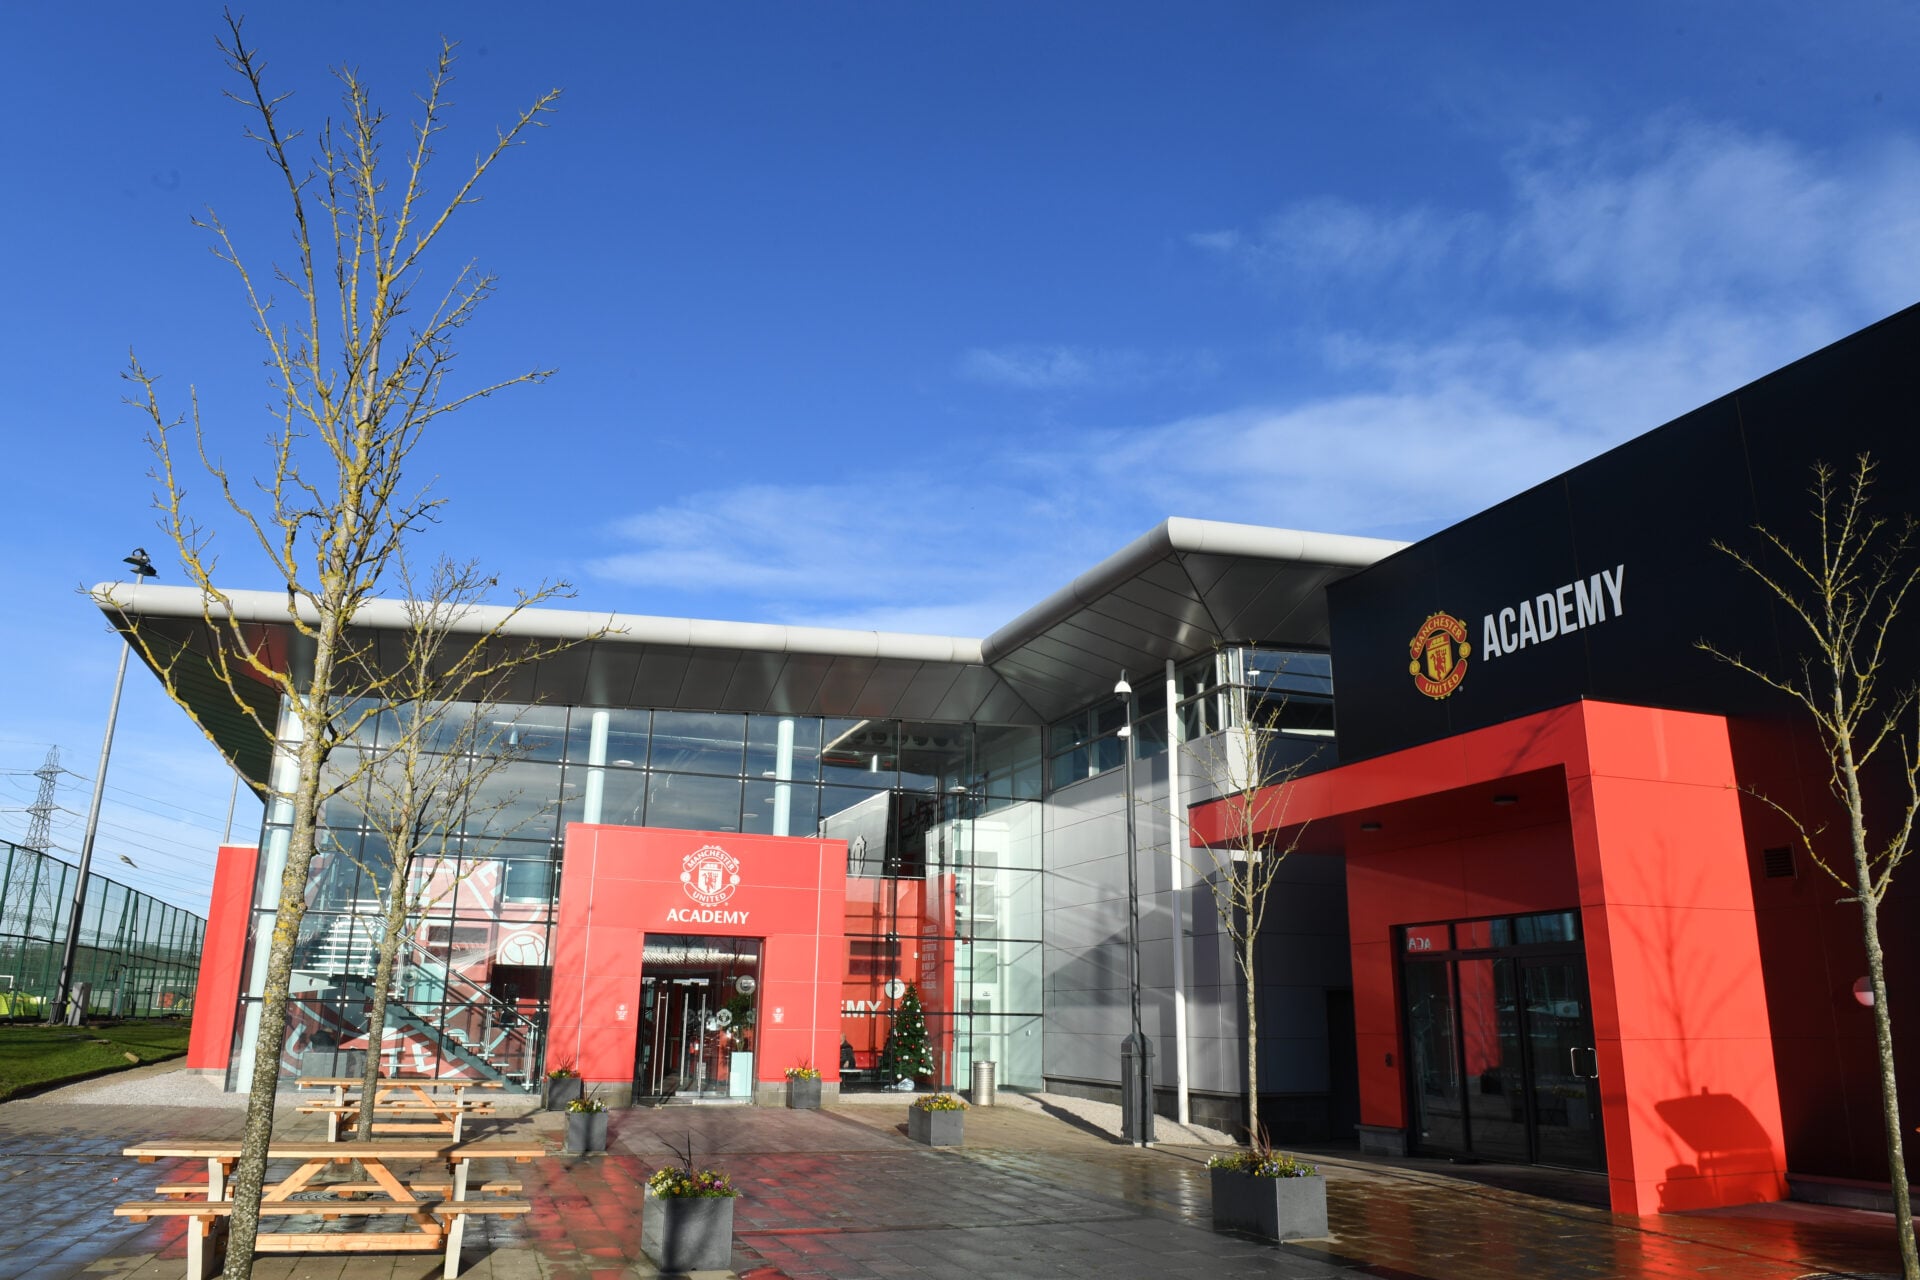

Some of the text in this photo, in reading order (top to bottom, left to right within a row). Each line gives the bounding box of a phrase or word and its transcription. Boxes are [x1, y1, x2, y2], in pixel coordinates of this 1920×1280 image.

[1483, 564, 1624, 662] ACADEMY
[1414, 617, 1462, 654] MANCHESTER
[1425, 674, 1459, 694] UNITED
[687, 849, 735, 871] MANCHESTER
[692, 891, 726, 903] UNITED
[666, 908, 750, 925] ACADEMY
